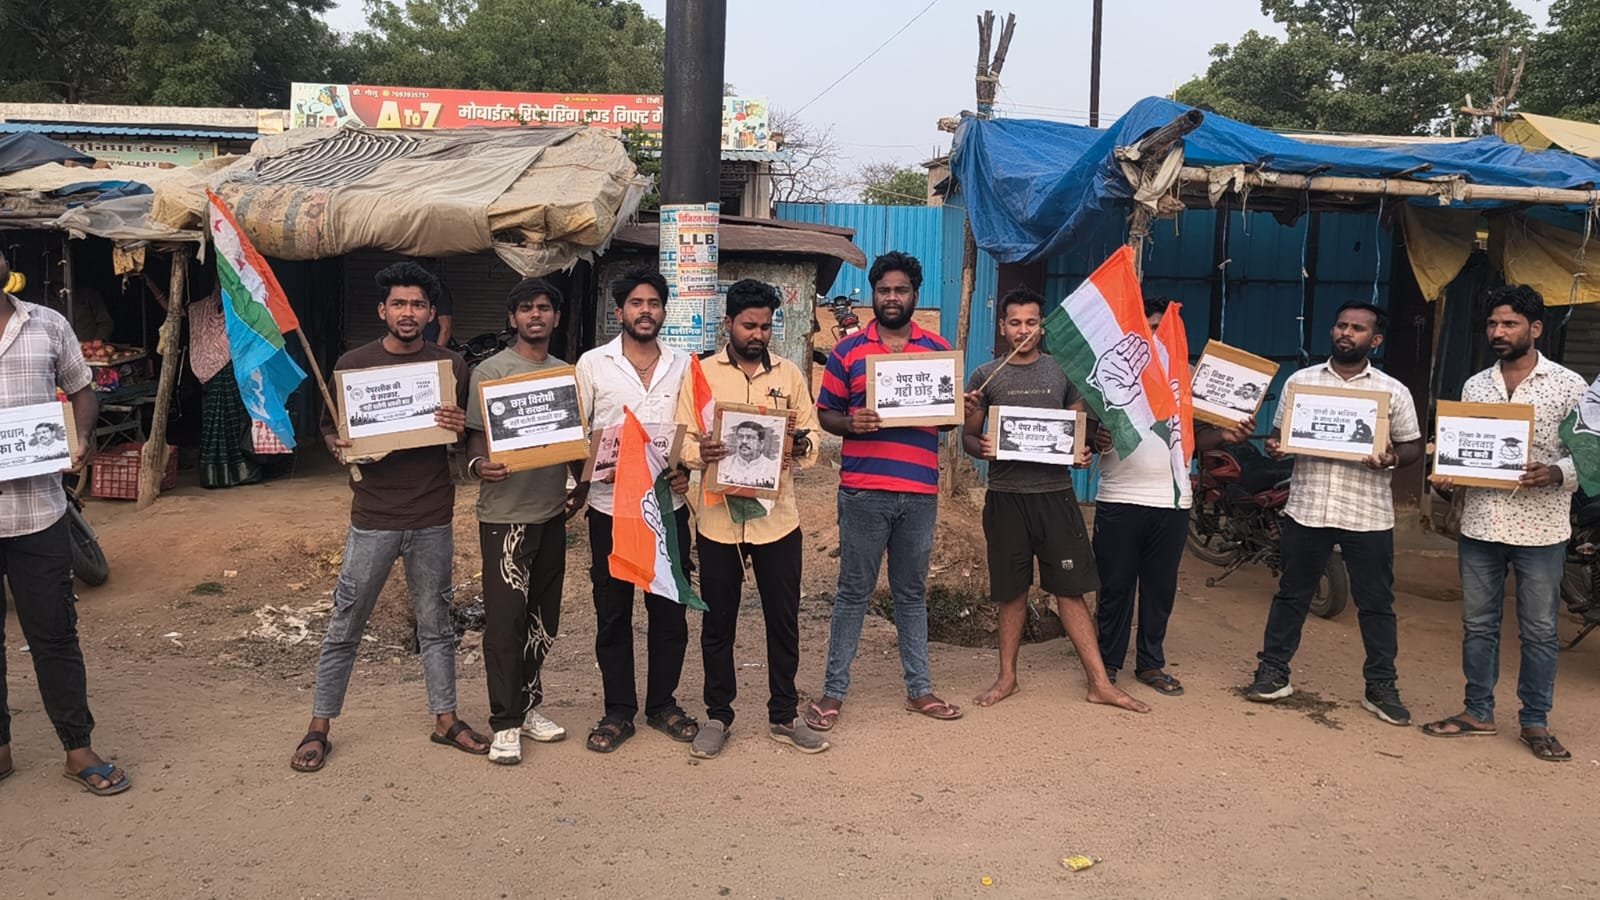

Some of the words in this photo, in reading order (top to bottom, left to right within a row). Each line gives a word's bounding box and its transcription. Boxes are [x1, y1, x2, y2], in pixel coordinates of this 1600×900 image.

[679, 234, 714, 244] LLB
[896, 372, 913, 383] पेपर
[510, 397, 527, 408] छात्र
[528, 391, 555, 405] विरोधी
[14, 439, 26, 452] दो
